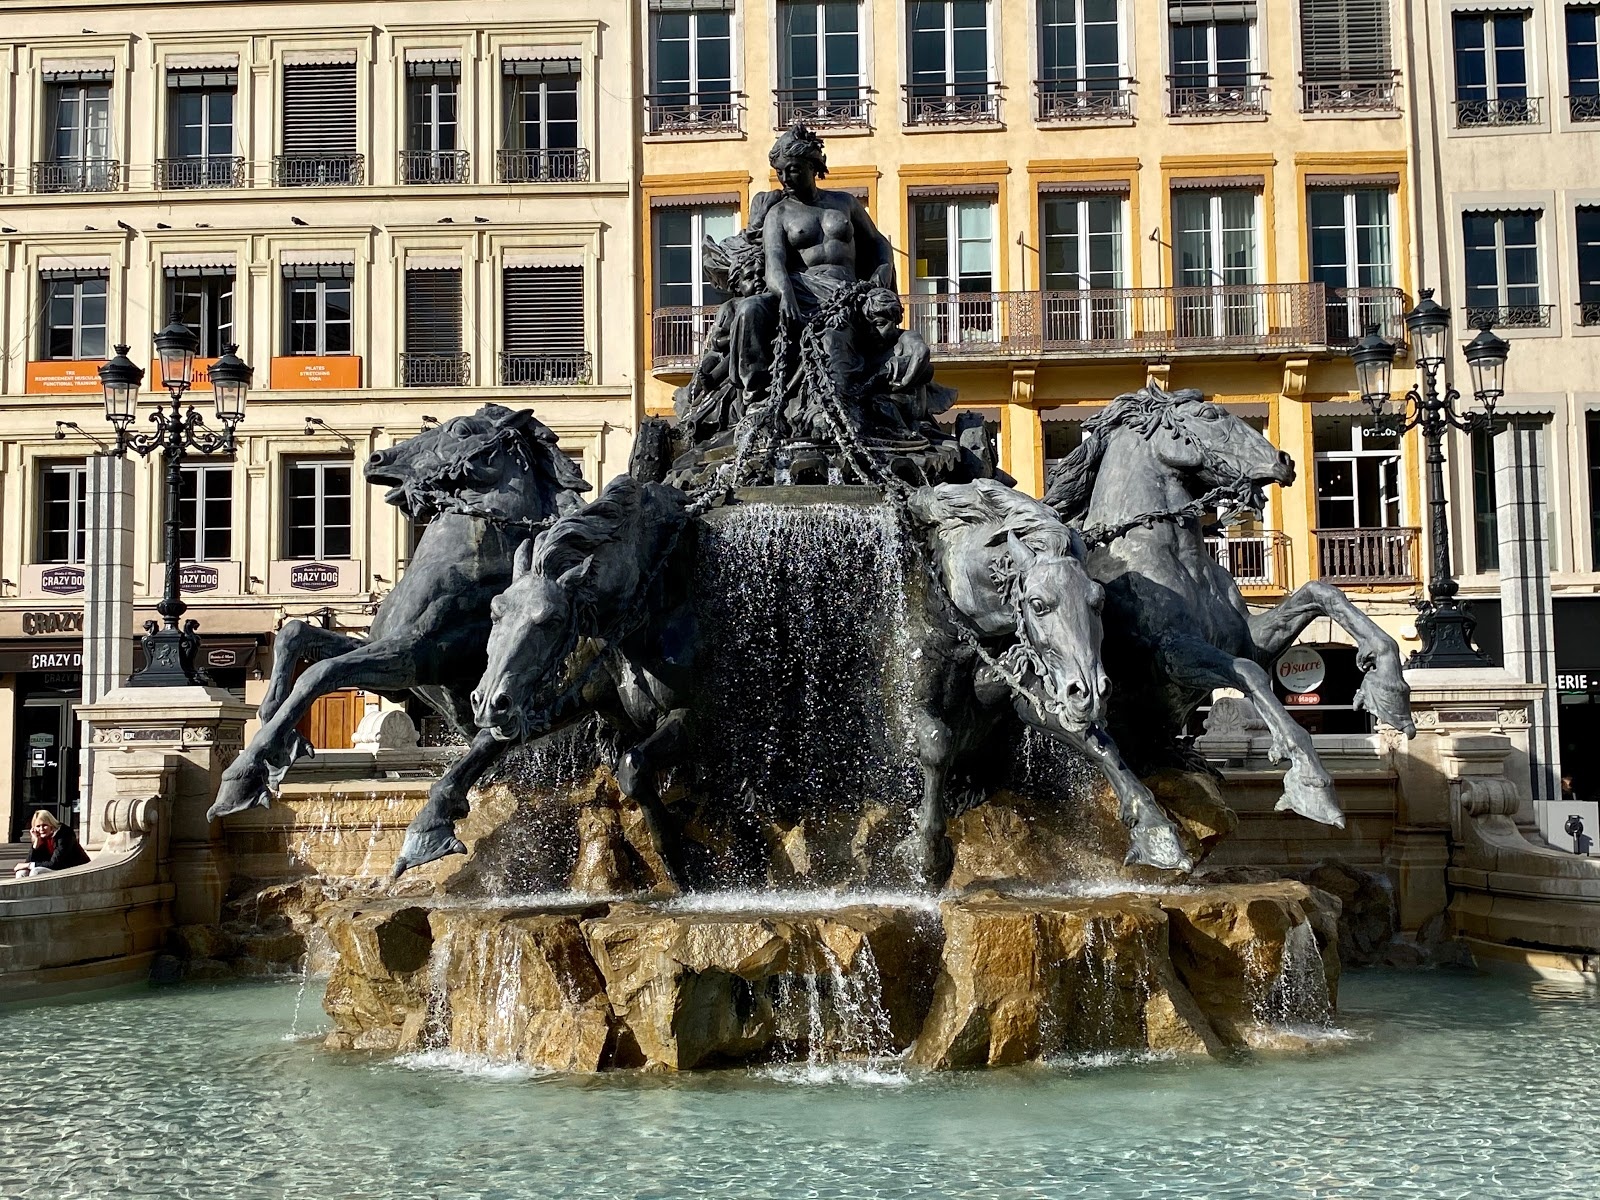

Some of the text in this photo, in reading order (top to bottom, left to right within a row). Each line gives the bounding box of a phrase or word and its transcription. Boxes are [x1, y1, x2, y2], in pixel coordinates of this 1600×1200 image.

[43, 576, 70, 586] CRAZY
[200, 574, 217, 584] DOG
[292, 572, 338, 582] CRAZY DOG
[23, 612, 82, 634] CRAZY
[32, 654, 70, 668] CRAZY
[1556, 674, 1587, 689] ERIE
